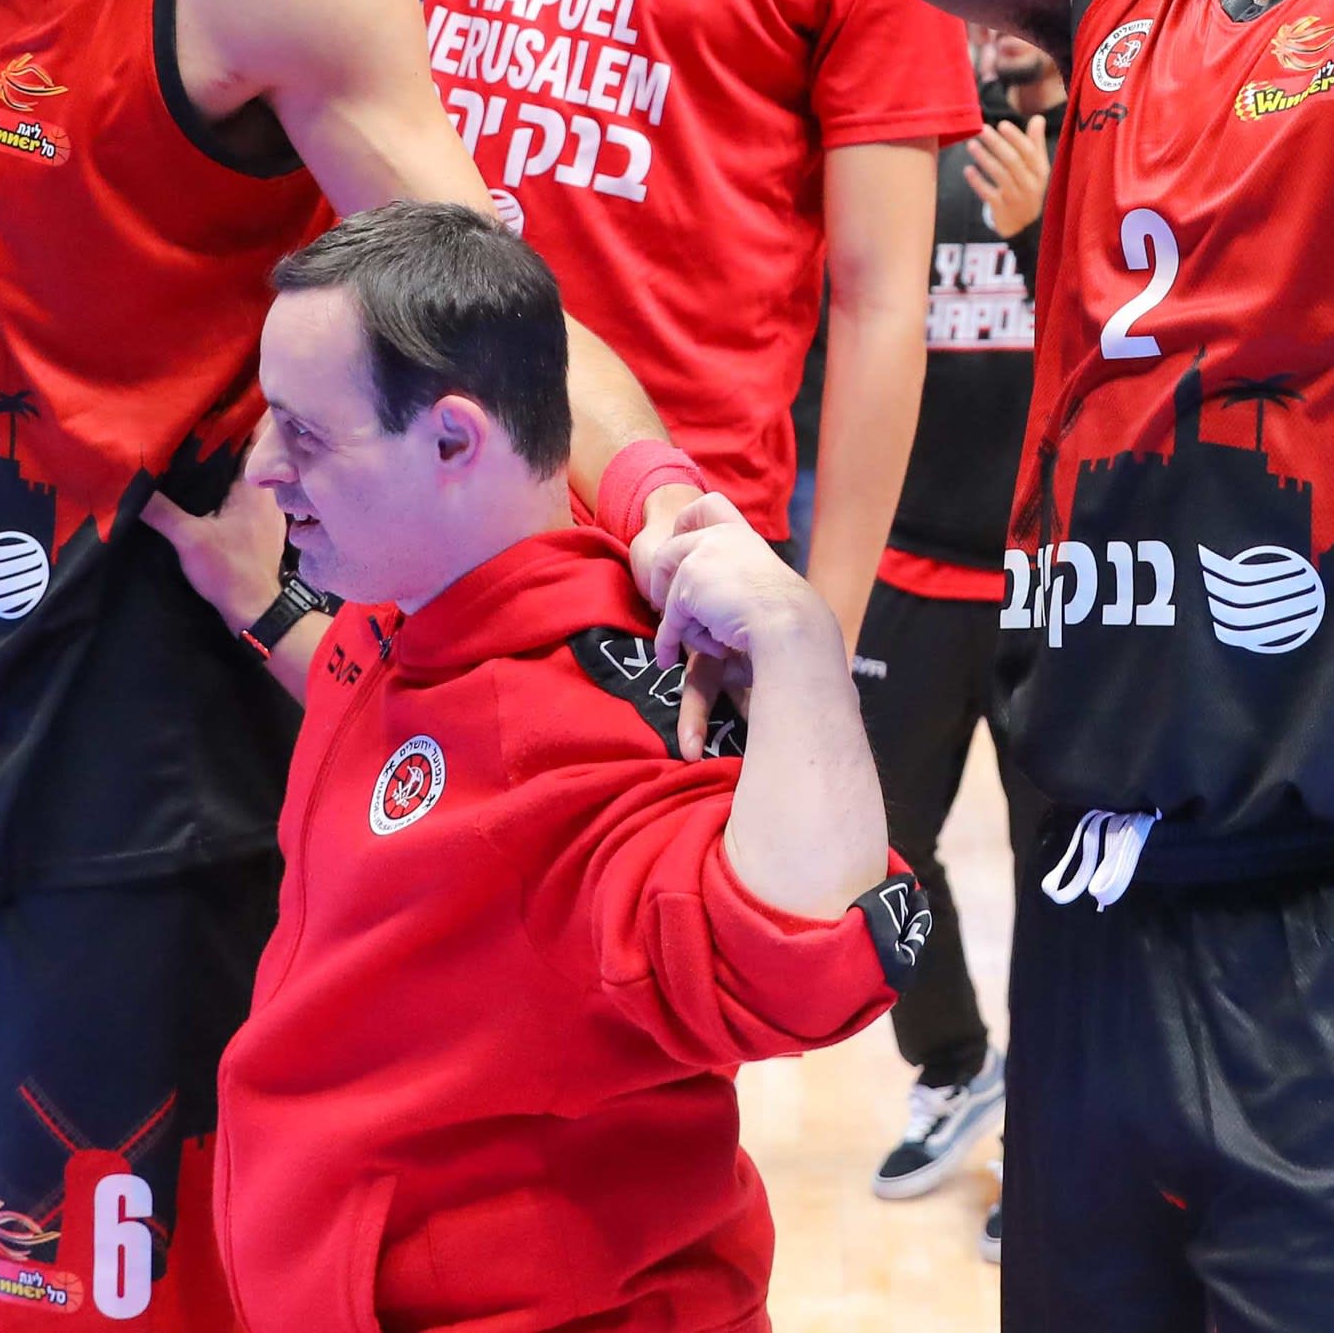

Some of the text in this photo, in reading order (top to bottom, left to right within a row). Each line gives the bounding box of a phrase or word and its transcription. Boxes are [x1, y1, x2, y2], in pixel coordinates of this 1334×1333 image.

[17, 122, 42, 140] ליגת
[40, 139, 55, 158] סל
[434, 83, 652, 203] בנק יה
[1100, 209, 1179, 360] 2
[1048, 540, 1176, 648] בנק
[46, 1285, 67, 1305] סל
[93, 1173, 153, 1320] 6
